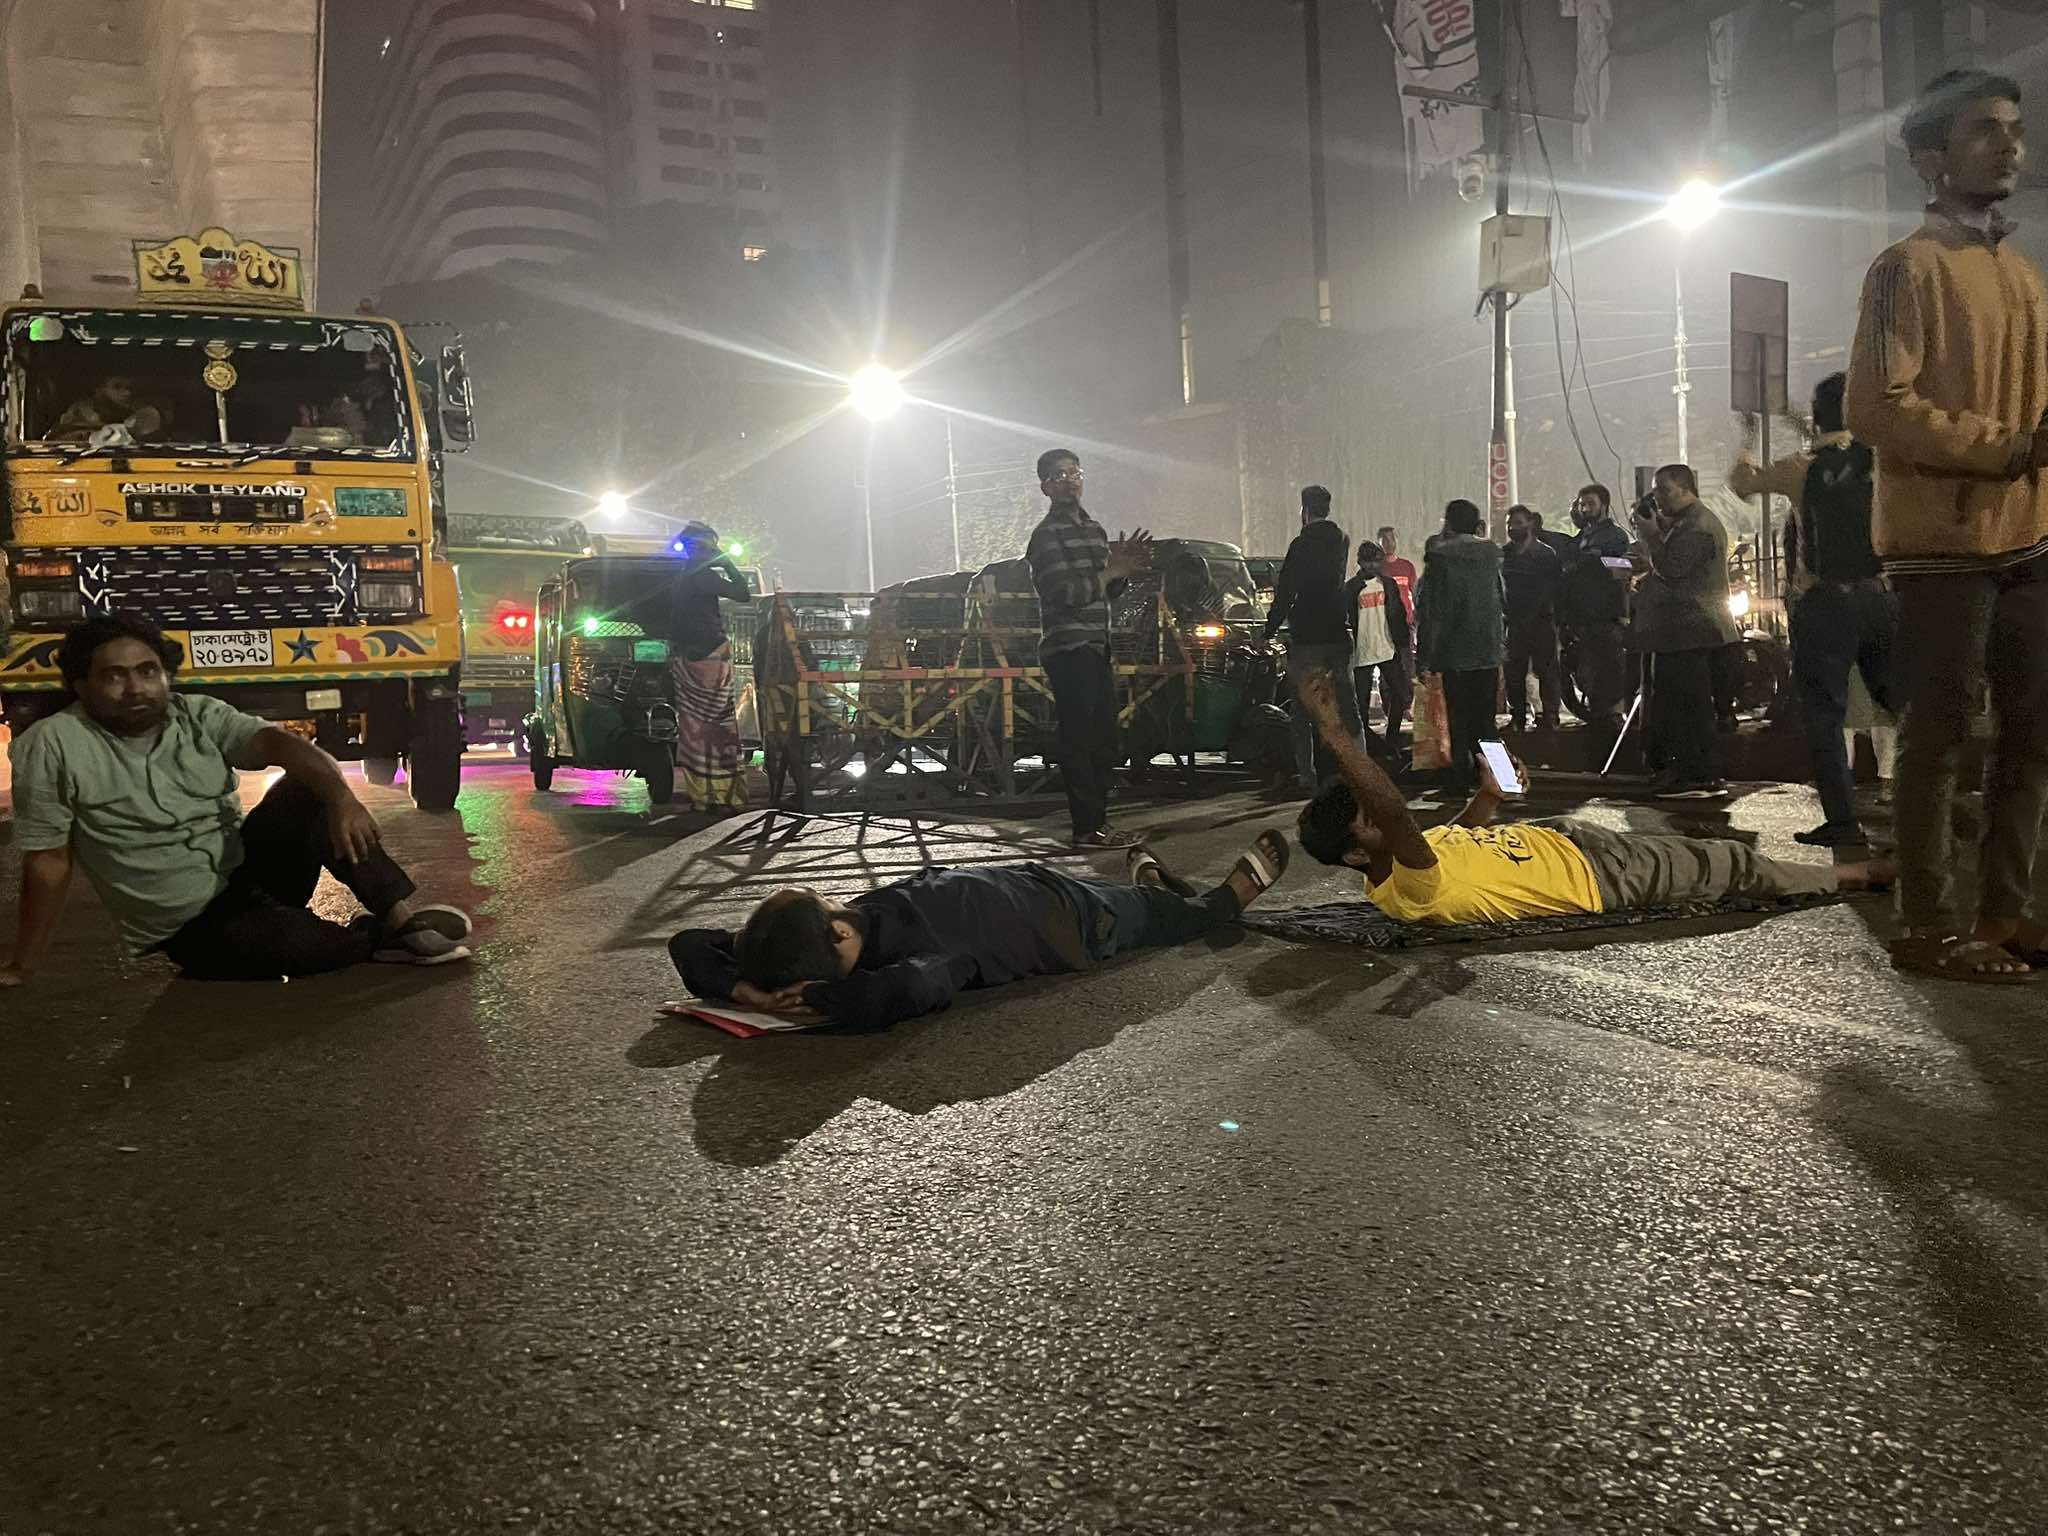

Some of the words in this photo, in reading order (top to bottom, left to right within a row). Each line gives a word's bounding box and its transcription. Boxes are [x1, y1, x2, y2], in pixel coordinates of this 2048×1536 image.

[239, 249, 287, 290] الله
[121, 483, 196, 494] ASHOK
[209, 484, 306, 497] LEYLAND
